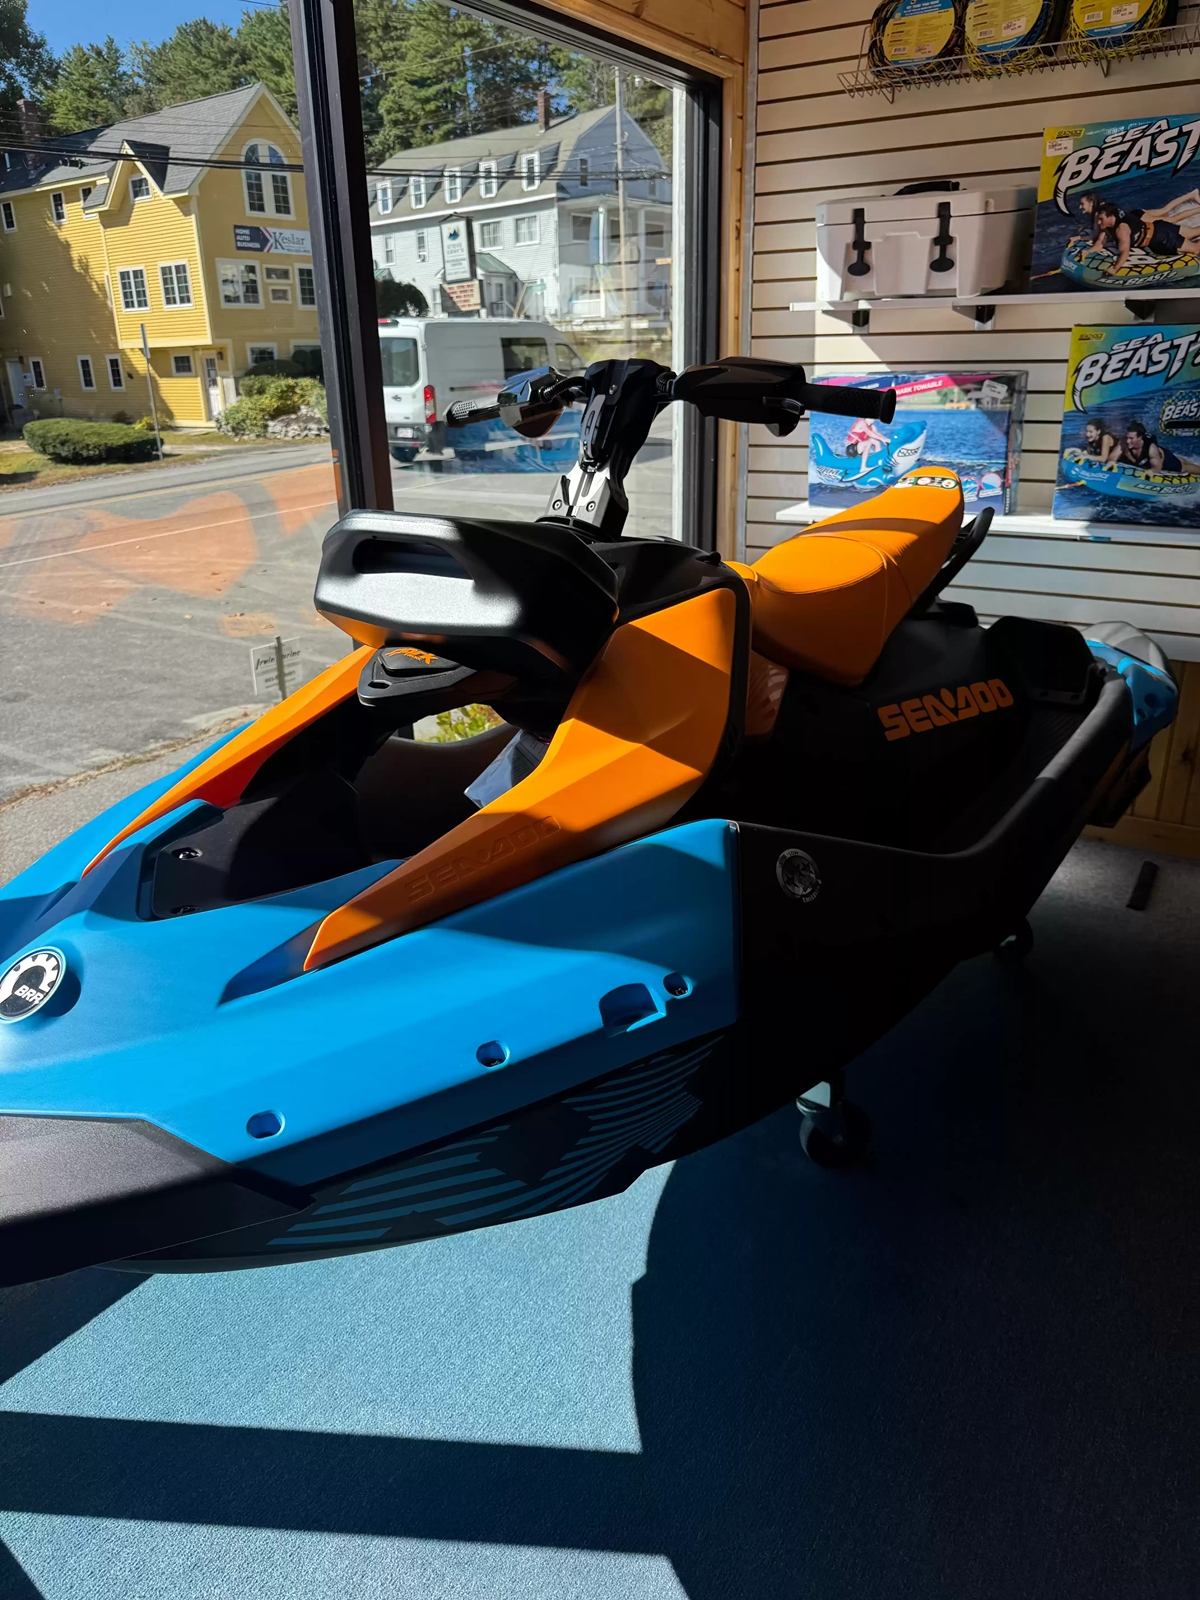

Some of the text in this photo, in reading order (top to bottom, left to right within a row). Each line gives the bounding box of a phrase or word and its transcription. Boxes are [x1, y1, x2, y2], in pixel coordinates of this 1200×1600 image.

[1101, 118, 1169, 148] SEA
[1054, 119, 1200, 216] BEAST
[272, 231, 306, 250] Keslar
[1110, 332, 1163, 352] SEA
[913, 379, 943, 391] TOWABLE
[1072, 332, 1198, 414] BEAST
